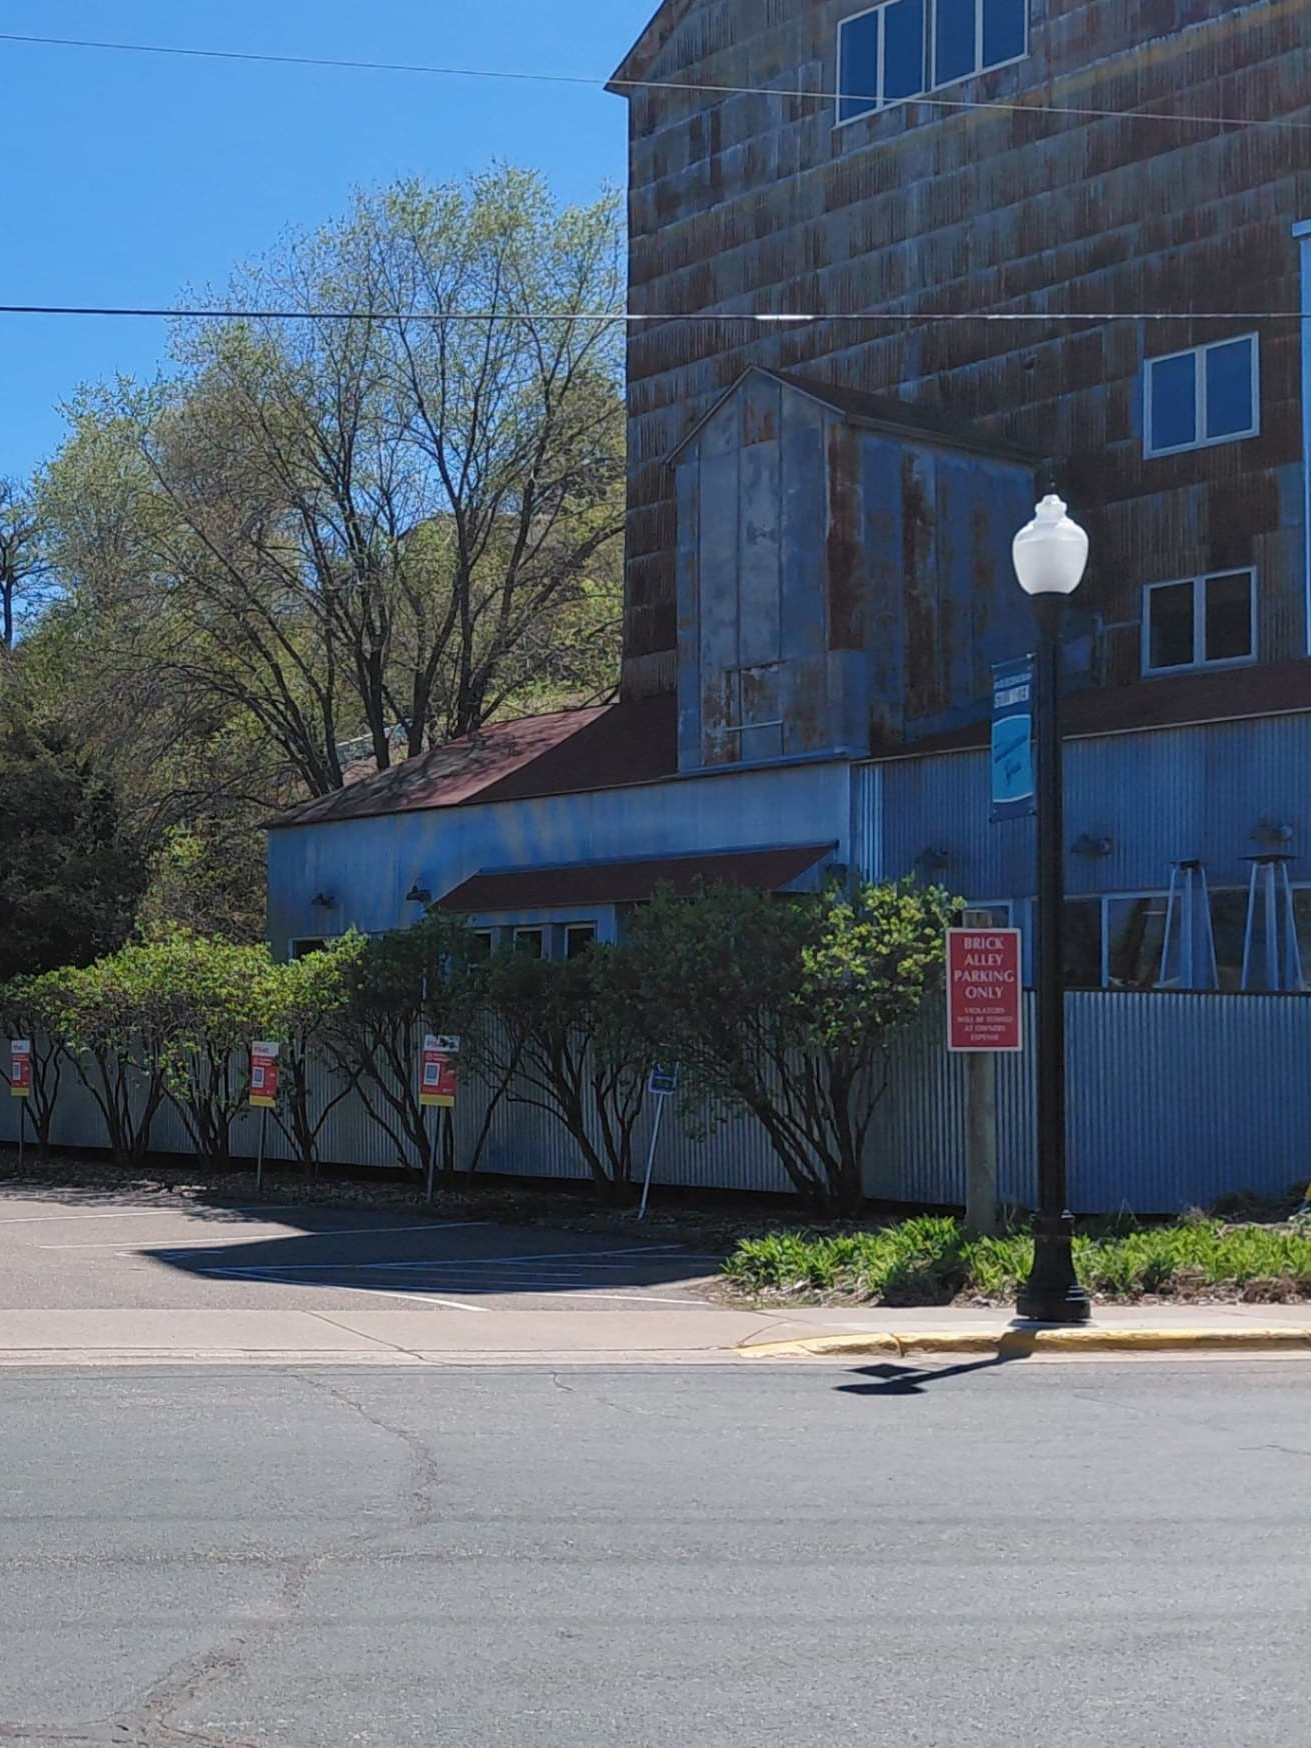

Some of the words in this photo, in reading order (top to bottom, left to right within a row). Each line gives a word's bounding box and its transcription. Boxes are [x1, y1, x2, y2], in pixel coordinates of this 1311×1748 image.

[964, 937, 1003, 949] BRICK
[964, 954, 1003, 966] ALLEY
[954, 970, 1015, 982] PARKING
[965, 987, 1003, 999] ONLY
